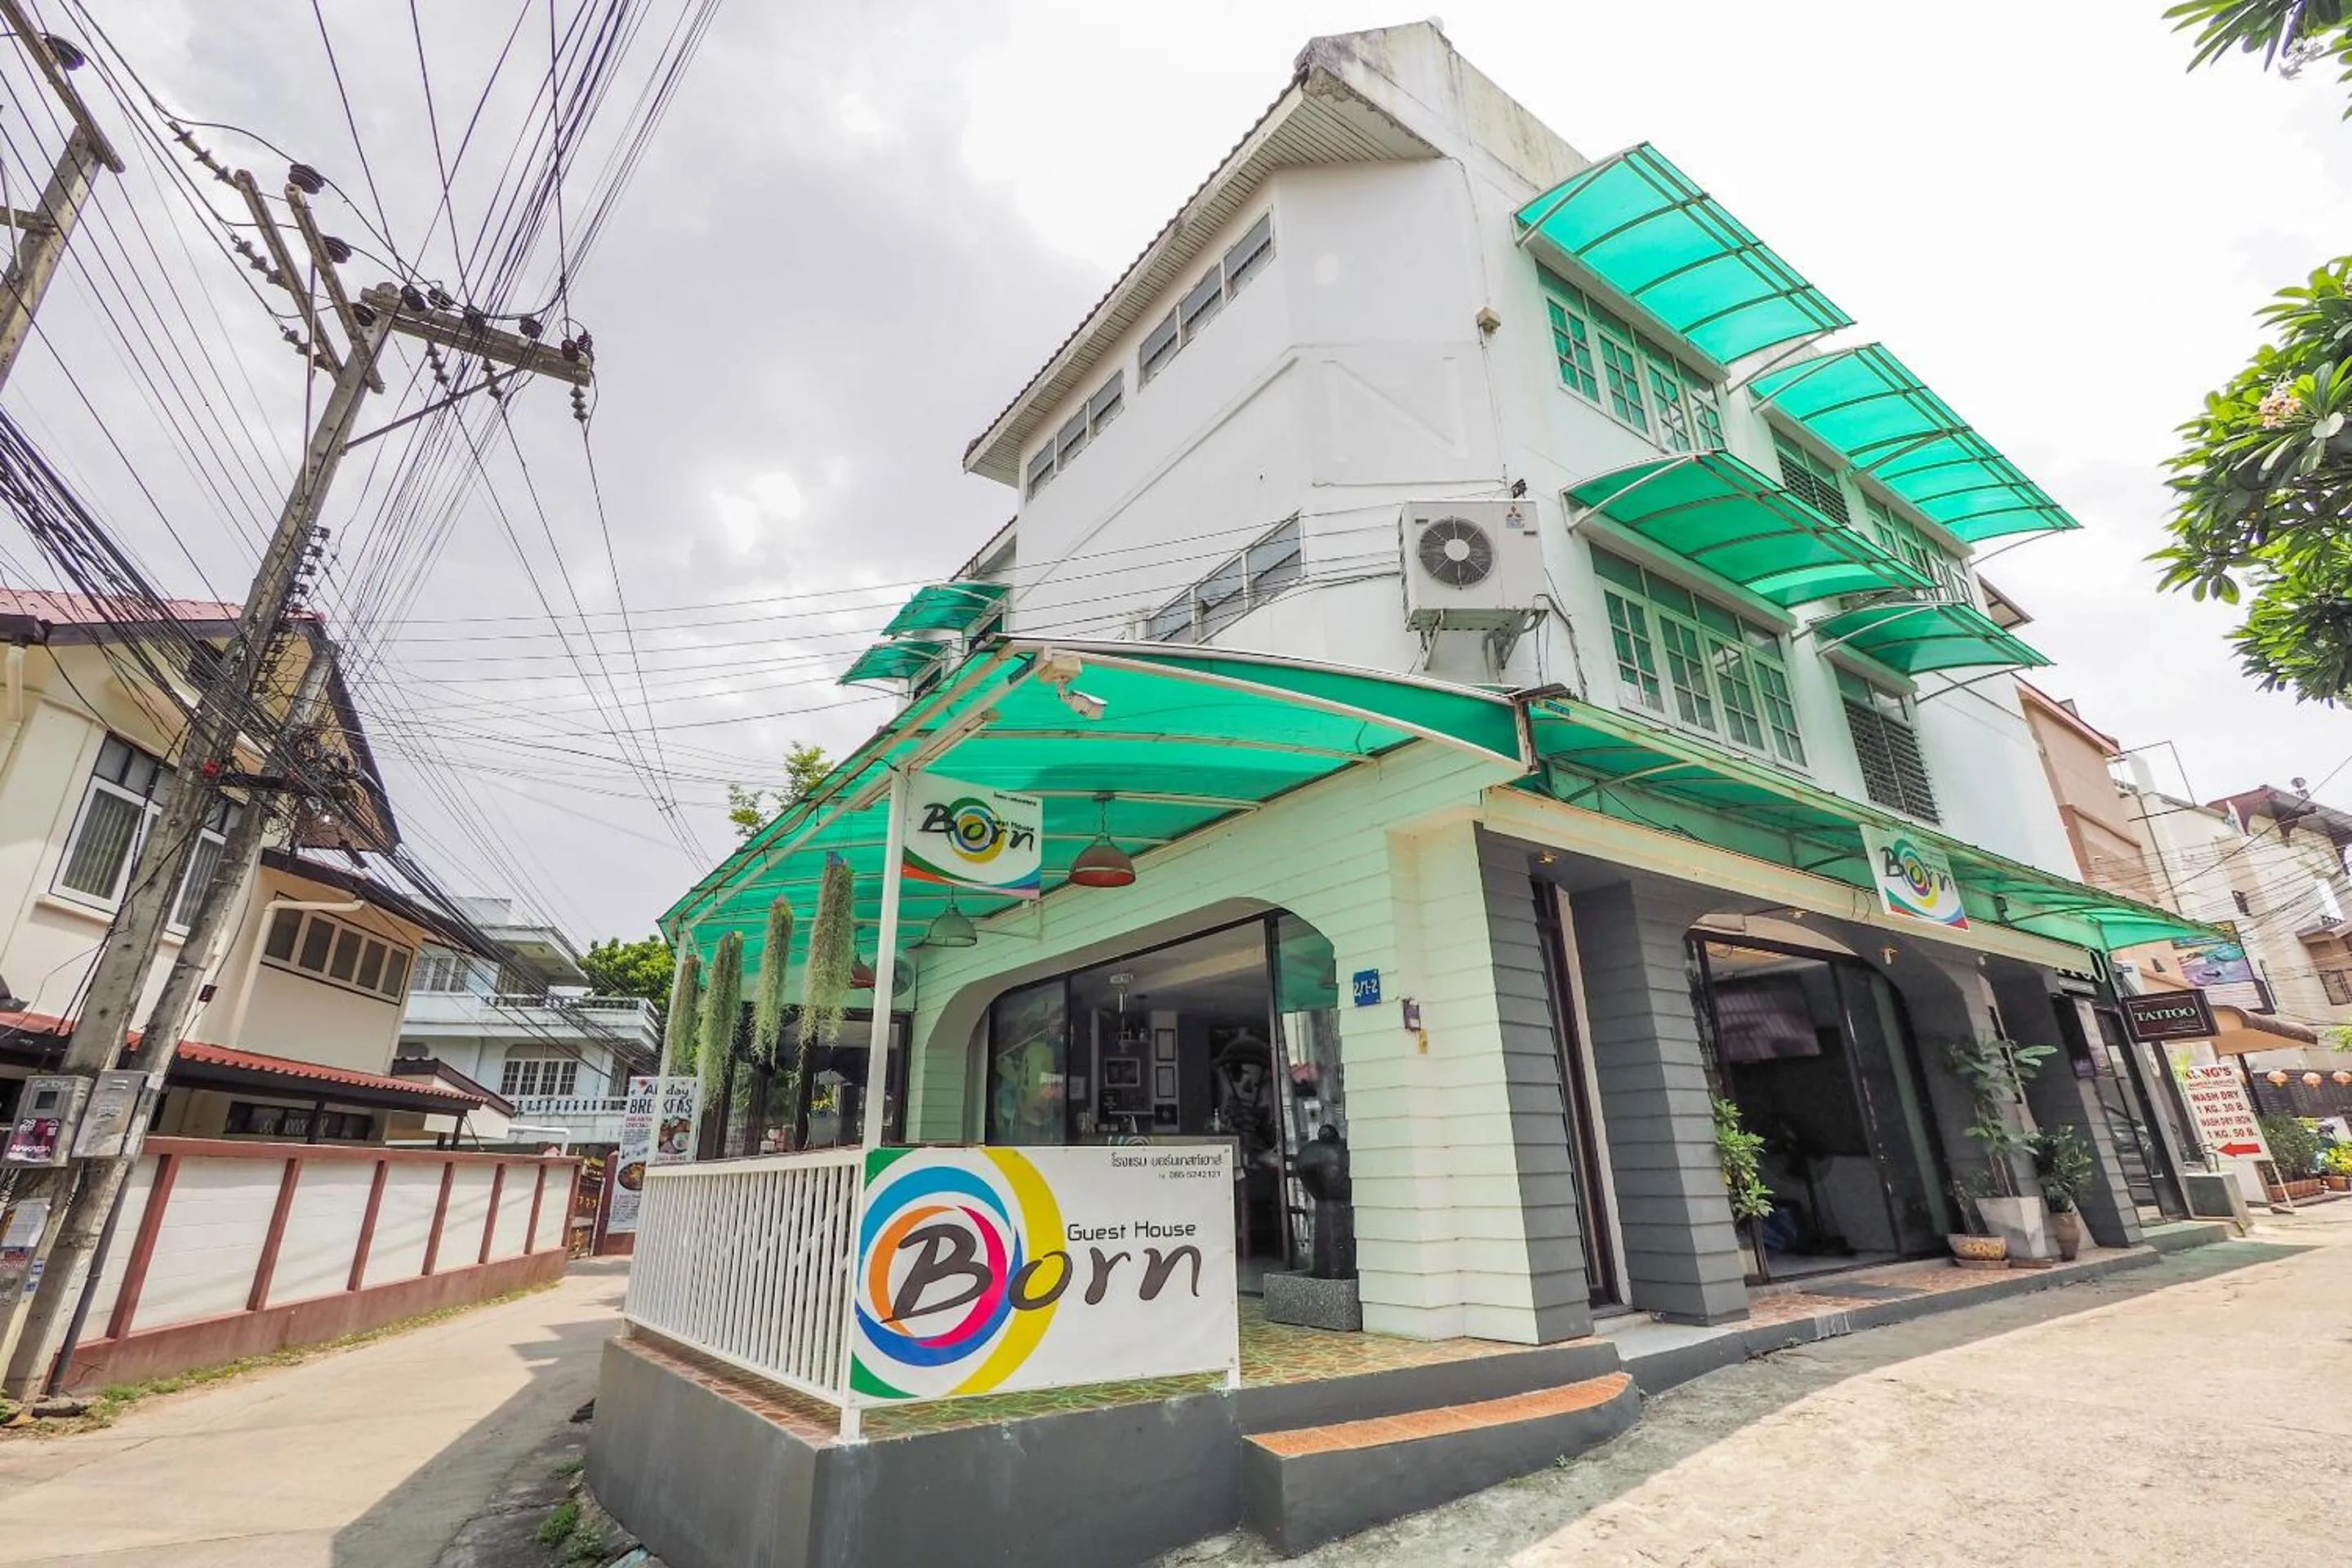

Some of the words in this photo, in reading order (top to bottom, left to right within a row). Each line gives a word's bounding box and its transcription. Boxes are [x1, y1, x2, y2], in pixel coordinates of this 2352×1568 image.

[918, 803, 1034, 852] Born
[1880, 846, 1953, 891] Born
[2134, 1006, 2196, 1022] TATTOO
[630, 1098, 693, 1114] BREKFAS
[2191, 1092, 2220, 1102] WASH
[2220, 1090, 2238, 1100] DRY
[1067, 1223, 1126, 1241] Guest
[1134, 1221, 1196, 1239] House
[880, 1223, 1202, 1324] Born
